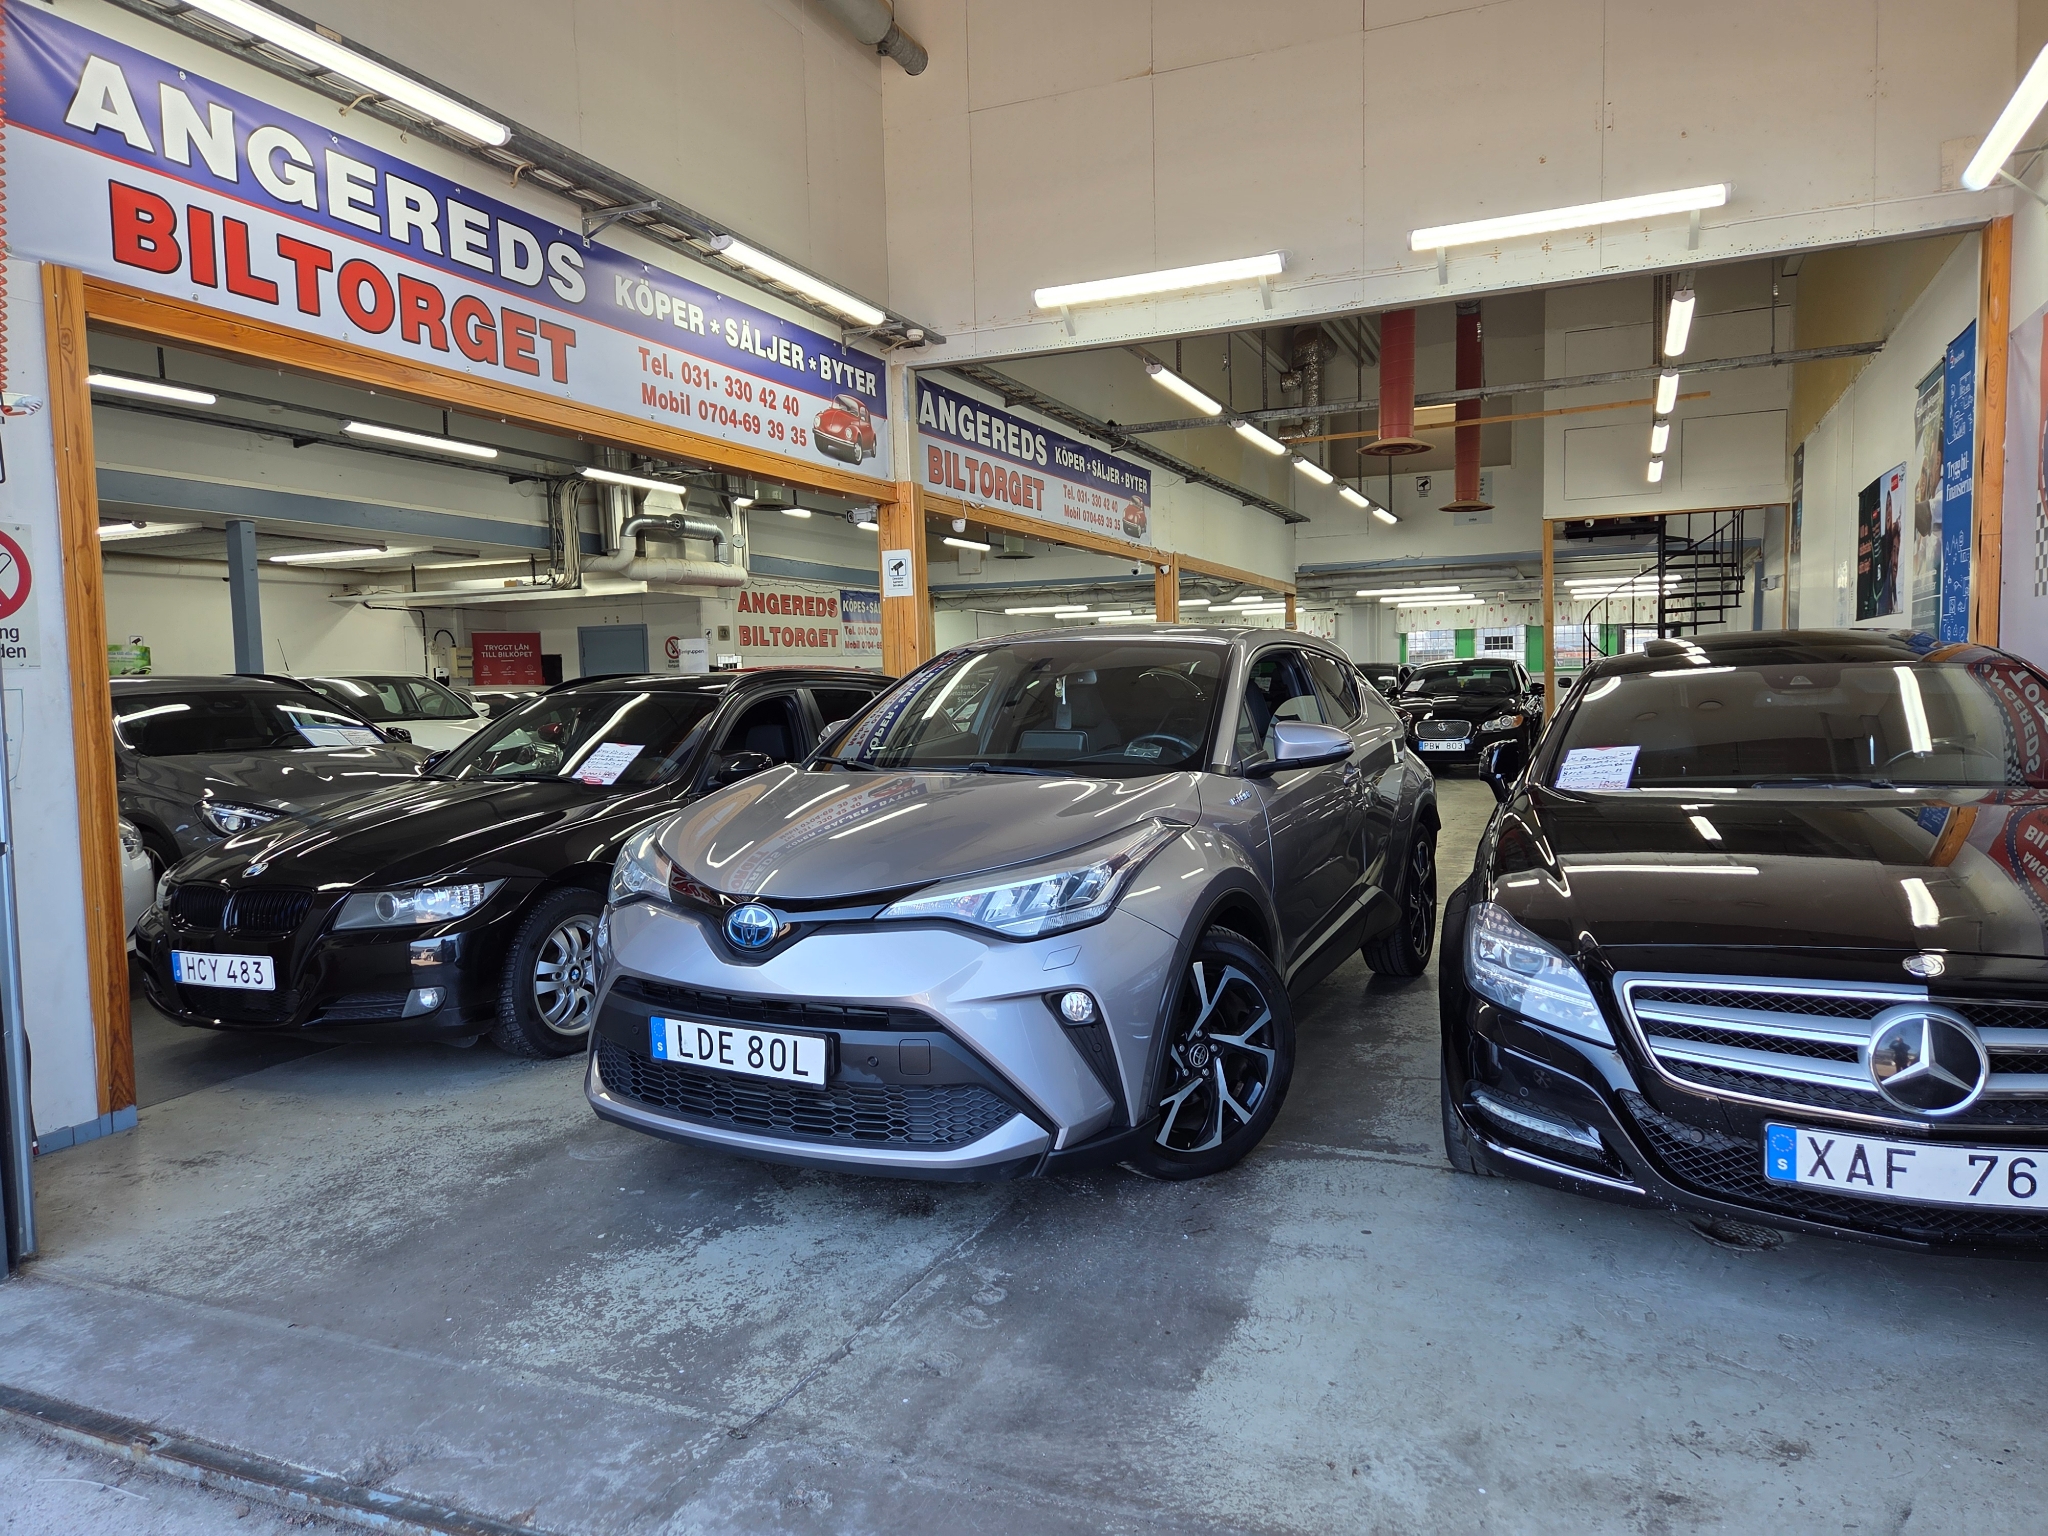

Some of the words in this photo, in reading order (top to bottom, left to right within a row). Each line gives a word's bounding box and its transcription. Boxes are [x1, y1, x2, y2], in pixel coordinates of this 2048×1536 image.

[65, 55, 587, 304] ANGEREDS
[108, 179, 577, 384] BILTORGET
[614, 275, 705, 336] KÖPER
[725, 318, 805, 371] SÄLJER
[819, 353, 877, 397] BYTER
[638, 346, 674, 380] Tel.
[681, 361, 718, 391] 031-
[725, 375, 753, 403] 330
[759, 387, 777, 410] 42
[783, 394, 800, 417] 40
[641, 383, 691, 416] Mobil
[698, 400, 761, 435] 0704-69
[767, 419, 785, 441] 39
[790, 428, 807, 447] 35
[919, 390, 1048, 466] ANGEREDS
[928, 444, 1044, 511] BILTORGET
[1055, 446, 1085, 472] KÖPER
[1092, 459, 1120, 485] SÄLJER
[1125, 473, 1148, 494] BYTER
[1063, 484, 1075, 500] Tel.
[1092, 493, 1101, 508] 330
[1103, 498, 1110, 510] 42
[1112, 500, 1118, 513] 40
[1064, 504, 1081, 520] Mobil
[1083, 510, 1104, 526] 0704-69
[1106, 516, 1112, 529] 39
[1114, 519, 1120, 530] 35
[738, 591, 838, 618] ANGEREDS
[843, 598, 865, 613] KÖPES
[498, 650, 533, 658] BILKÖPET
[739, 625, 838, 648] BILTORGET
[844, 626, 856, 635] Tel.
[845, 640, 860, 649] Mobil
[186, 956, 218, 982] HCY
[227, 960, 264, 985] 483
[677, 1024, 734, 1065] LDE
[747, 1035, 809, 1077] 80L
[1807, 1136, 1916, 1189] XAF
[1968, 1154, 2038, 1199] 76
